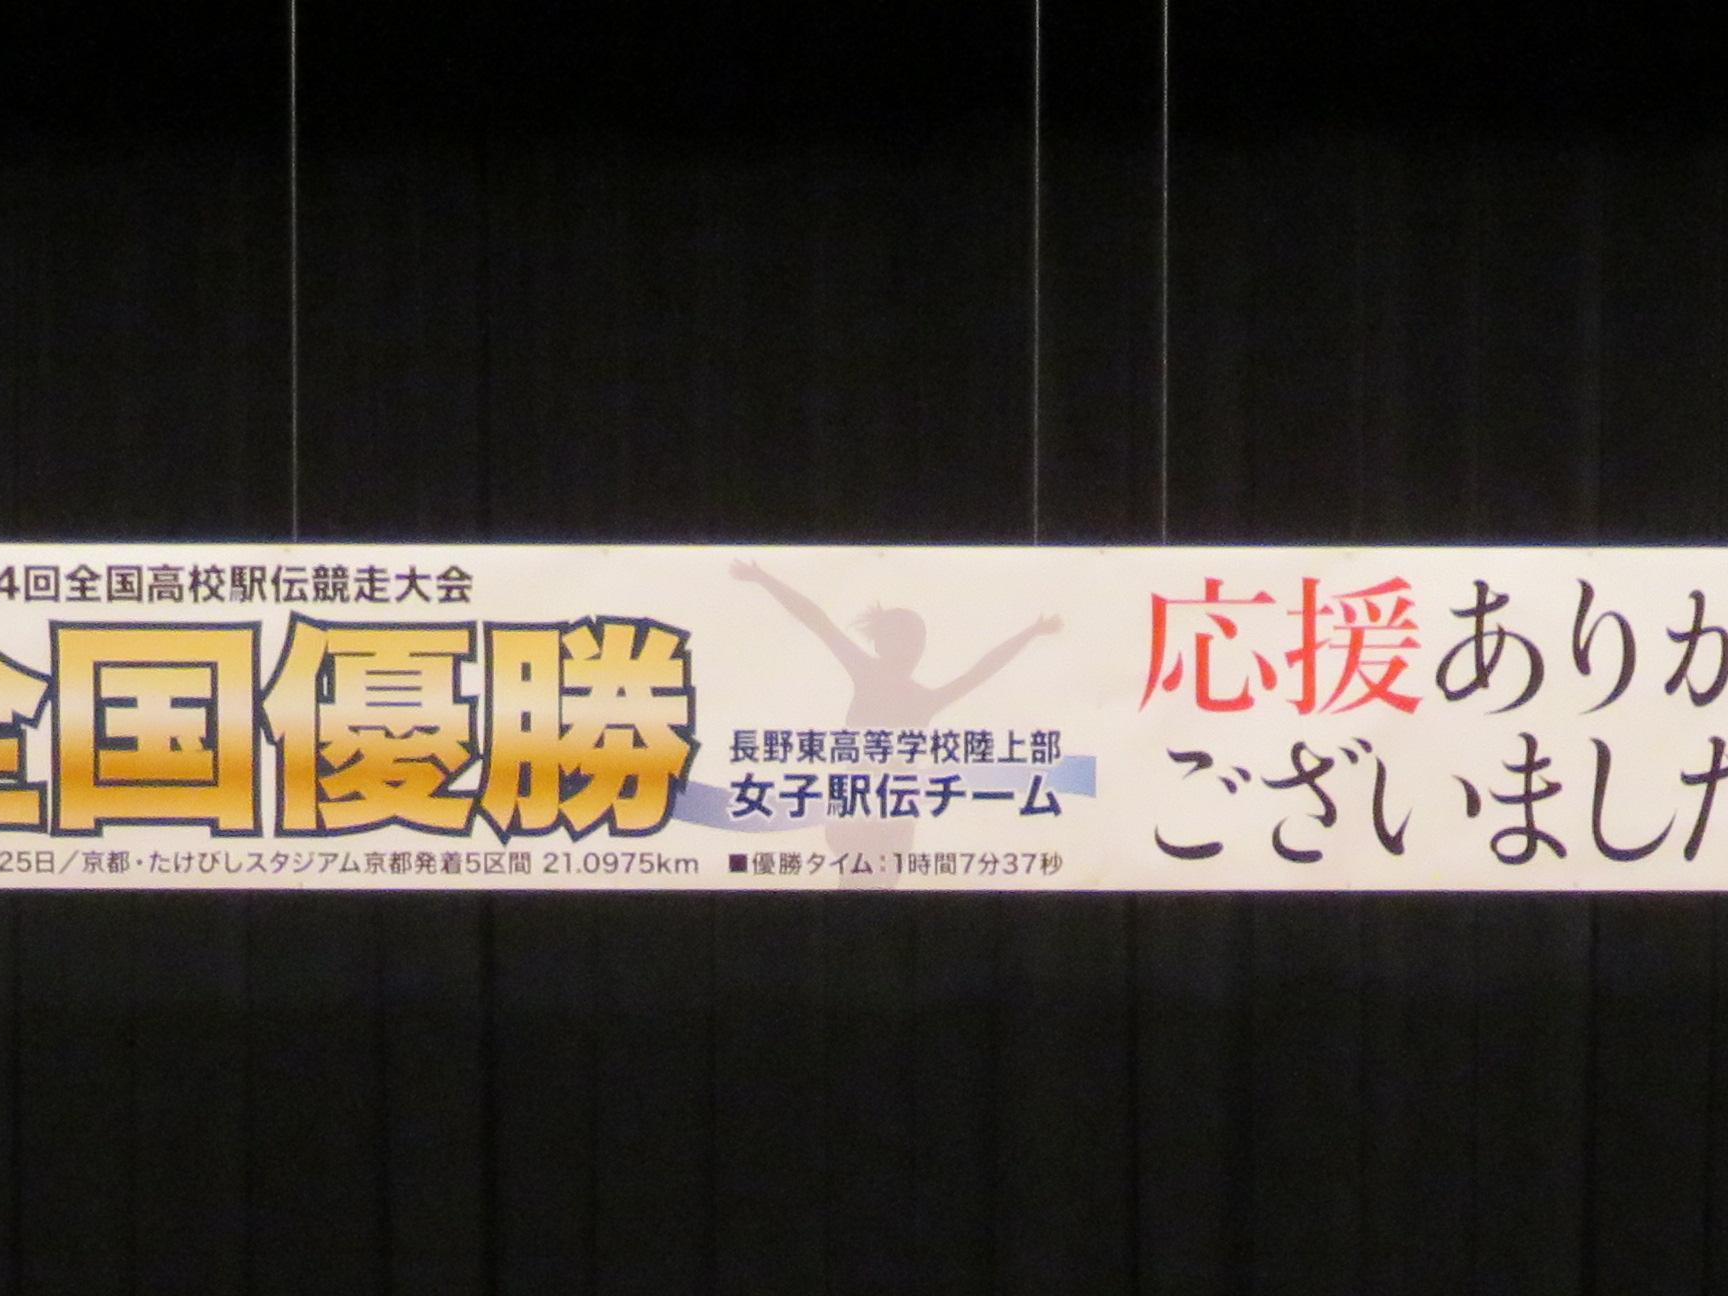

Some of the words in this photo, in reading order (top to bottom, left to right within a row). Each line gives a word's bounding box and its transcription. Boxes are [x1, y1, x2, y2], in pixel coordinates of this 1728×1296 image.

[729, 730, 1062, 765] 長野東高等学校陸上部
[729, 774, 1063, 819] 女子駅伝チーム
[543, 853, 701, 876] 21.0975km
